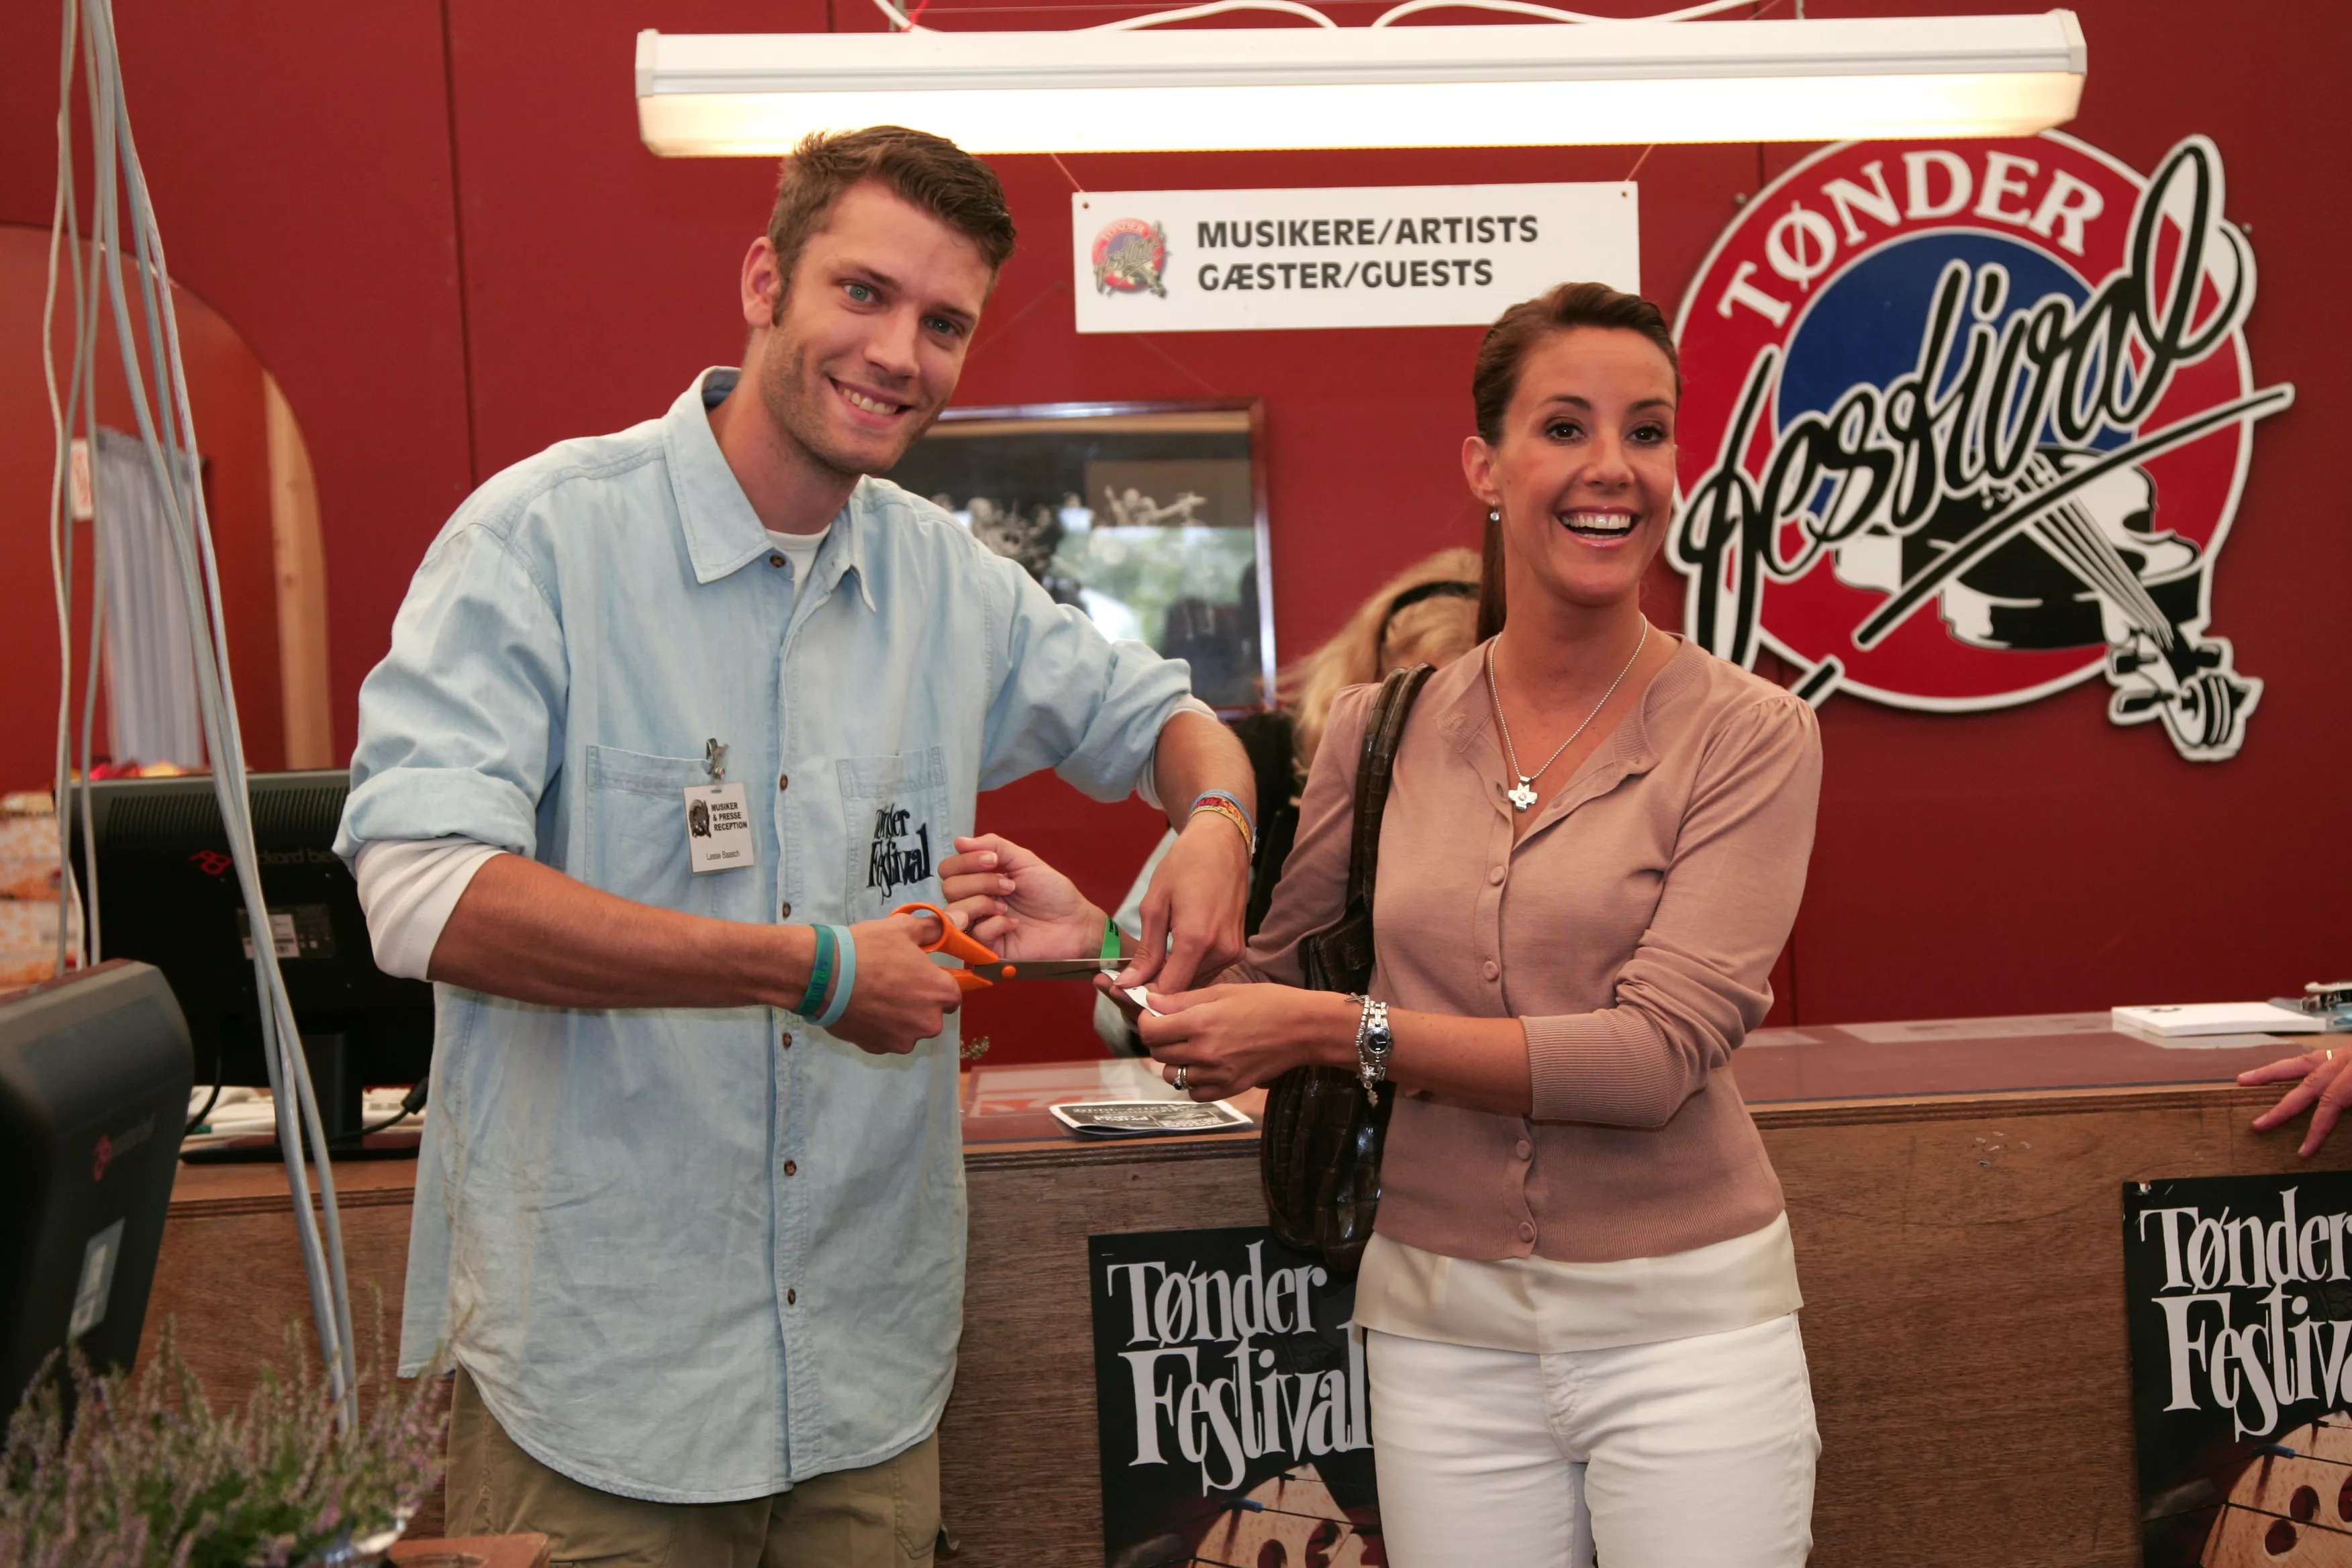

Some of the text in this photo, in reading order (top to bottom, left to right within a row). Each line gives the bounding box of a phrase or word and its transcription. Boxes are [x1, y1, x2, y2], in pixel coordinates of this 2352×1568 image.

[1197, 215, 1538, 248] MUSIKERE/ARTISTS
[1717, 149, 2105, 328] TØNDER
[1198, 260, 1493, 291] GÆSTER/GUESTS
[711, 802, 738, 811] MUSIKER
[714, 821, 748, 831] RECEPTION
[719, 812, 741, 820] PRESSE
[866, 822, 934, 905] Festival
[2139, 1185, 2352, 1295] Tønder
[1107, 1240, 1327, 1348] Tønder
[1118, 1320, 1373, 1498] Festival
